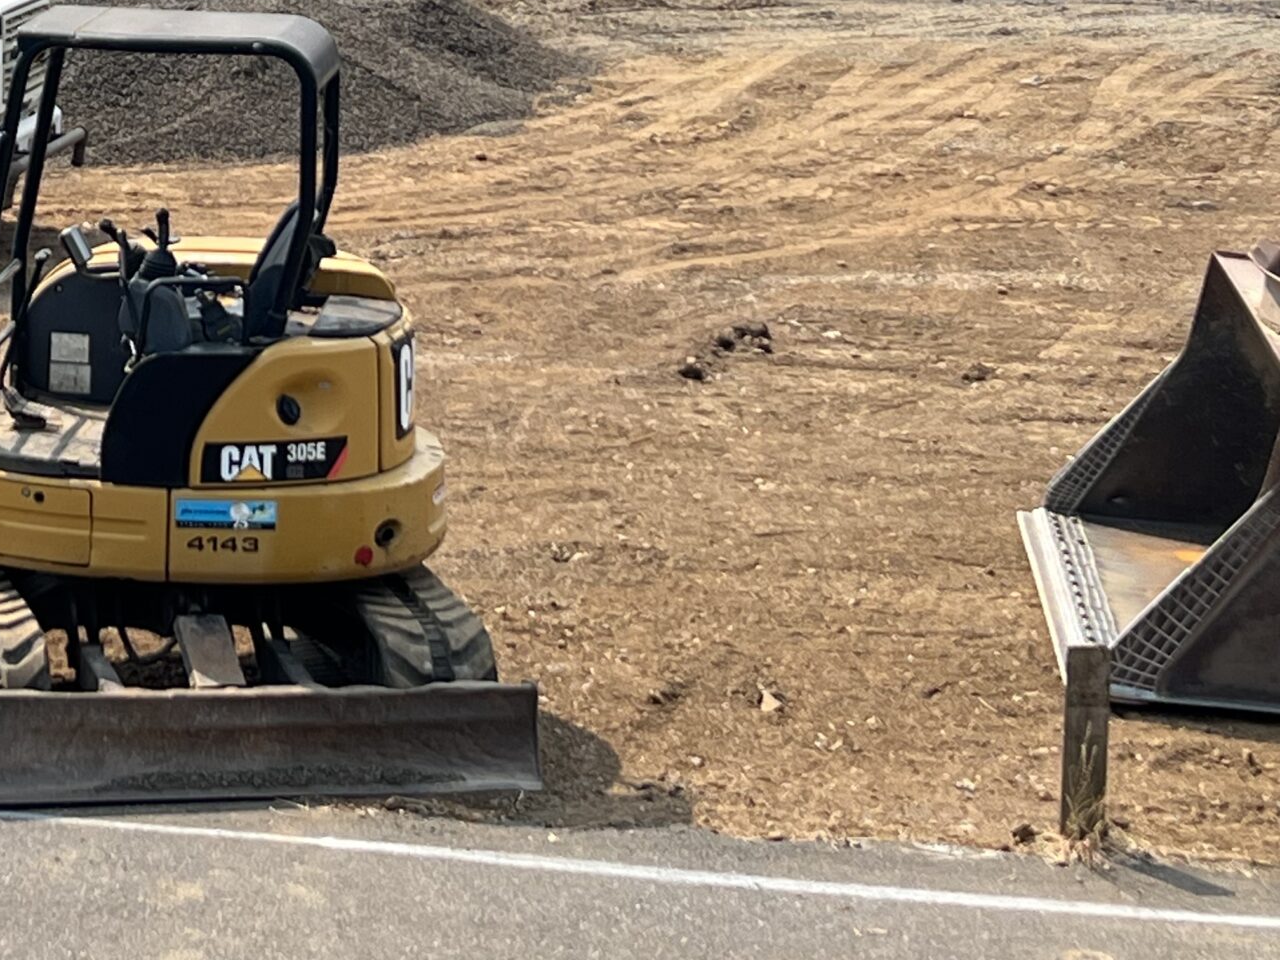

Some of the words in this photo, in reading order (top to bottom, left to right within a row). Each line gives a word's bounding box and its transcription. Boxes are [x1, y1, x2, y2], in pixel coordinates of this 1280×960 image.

[220, 444, 277, 481] CAT
[286, 442, 326, 462] 305E
[187, 536, 259, 552] 4143
